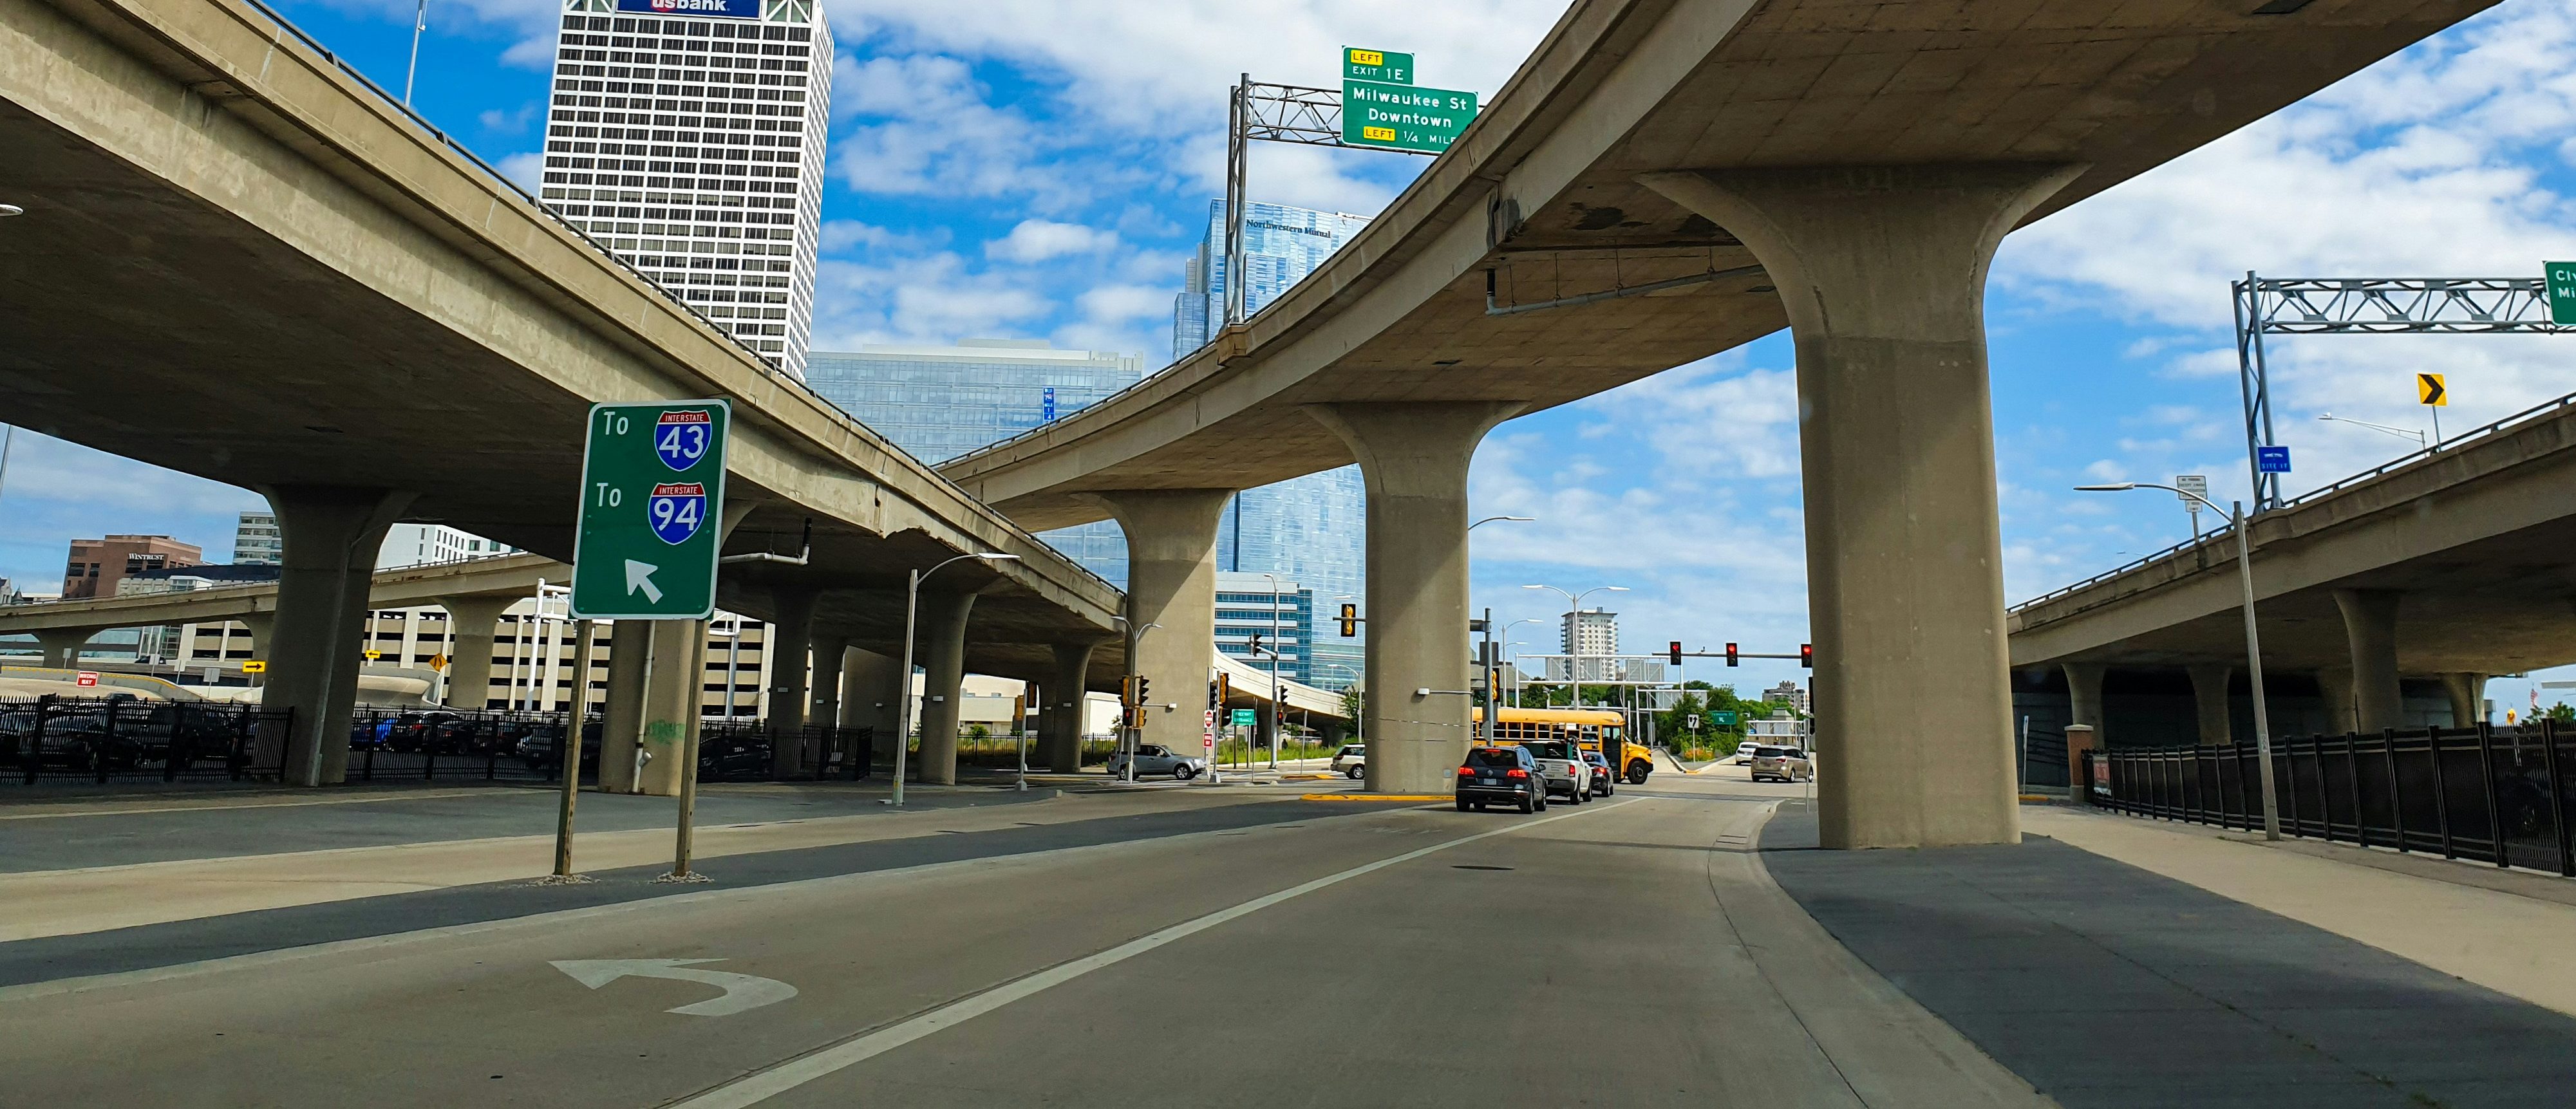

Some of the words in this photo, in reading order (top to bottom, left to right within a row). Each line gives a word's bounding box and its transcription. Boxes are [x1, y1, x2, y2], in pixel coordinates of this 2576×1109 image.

[1353, 53, 1380, 62] LEFT
[1353, 66, 1377, 76] EXIT
[1386, 68, 1404, 80] 1E
[1353, 87, 1440, 107] Milwaukee
[1449, 97, 1467, 111] St
[1369, 107, 1452, 128] Downtown
[1366, 129, 1393, 138] LEFT
[1246, 219, 1302, 233] Northwestern
[1304, 227, 1331, 238] Mutual
[2557, 287, 2575, 298] Mi
[604, 411, 628, 435] To
[665, 414, 704, 422] INTERSTATE
[659, 425, 704, 459] 43
[597, 482, 621, 507] To
[659, 487, 698, 495] INTERSTATE
[654, 498, 697, 531] 94
